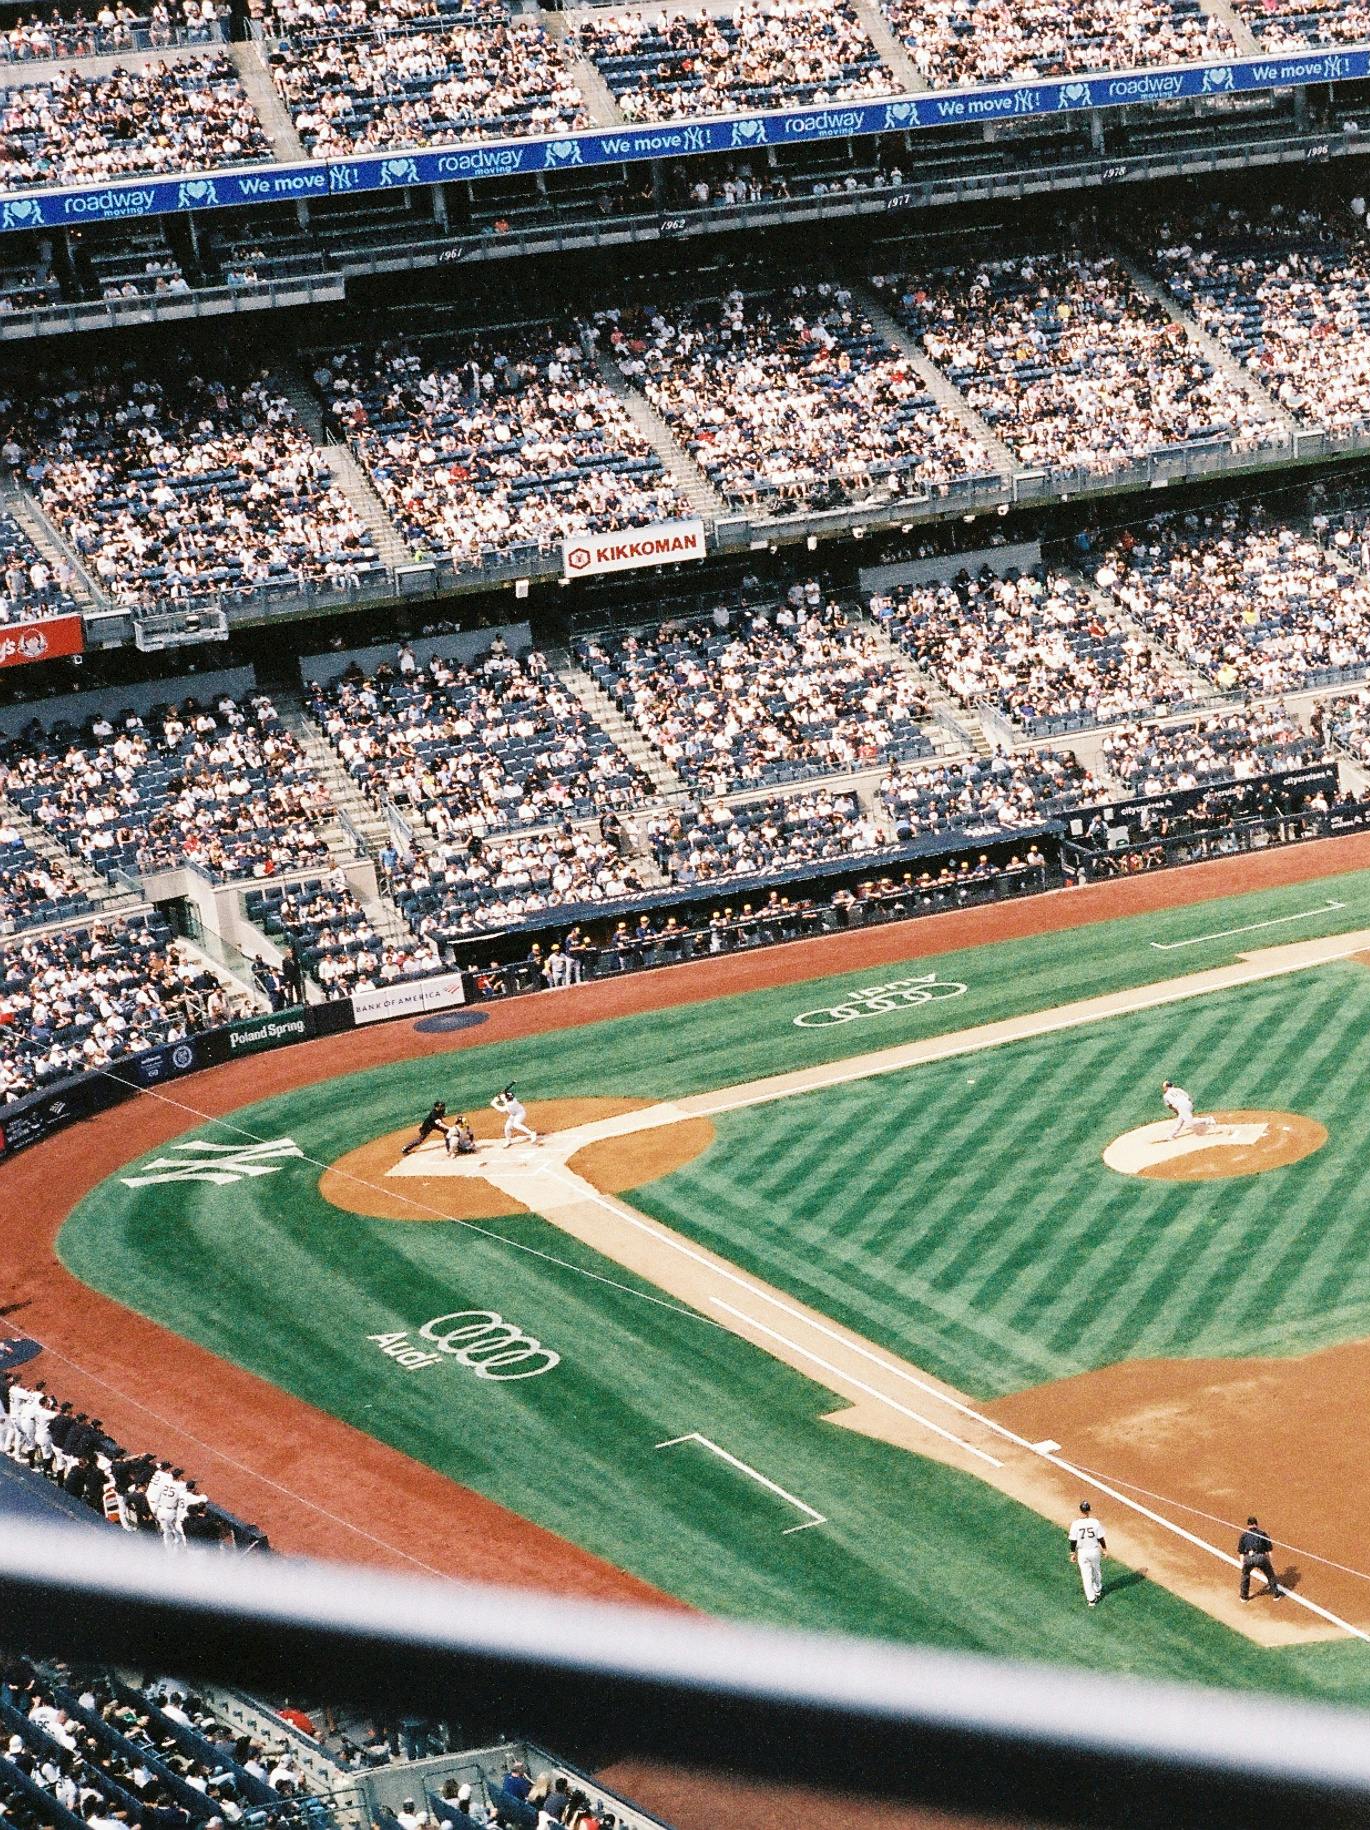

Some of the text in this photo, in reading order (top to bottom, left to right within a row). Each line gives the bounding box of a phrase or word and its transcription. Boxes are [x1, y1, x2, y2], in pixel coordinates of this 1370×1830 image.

[1253, 64, 1278, 81] We
[1281, 62, 1322, 78] move
[1108, 74, 1183, 97] roadway
[937, 99, 965, 117] We
[967, 97, 1012, 115] move
[785, 111, 864, 133] roadway
[600, 136, 630, 155] We
[634, 134, 681, 152] move
[1307, 145, 1328, 157] 1996
[438, 149, 523, 172] roadway
[474, 164, 512, 175] moving
[1103, 166, 1127, 179] 1978
[239, 179, 273, 196] We
[275, 175, 325, 193] move
[64, 188, 155, 214] roadway
[887, 194, 911, 209] 1977
[104, 206, 144, 217] moving
[660, 218, 686, 231] 1962
[438, 248, 463, 261] 1961
[596, 534, 697, 563] KIKKOMAN
[847, 973, 935, 999] Audi
[356, 991, 440, 1013] BANK OF AMERICA
[230, 1020, 305, 1048] Poland Spring
[366, 1330, 443, 1371] Audi
[162, 1485, 176, 1498] 25
[1078, 1527, 1096, 1540] 75
